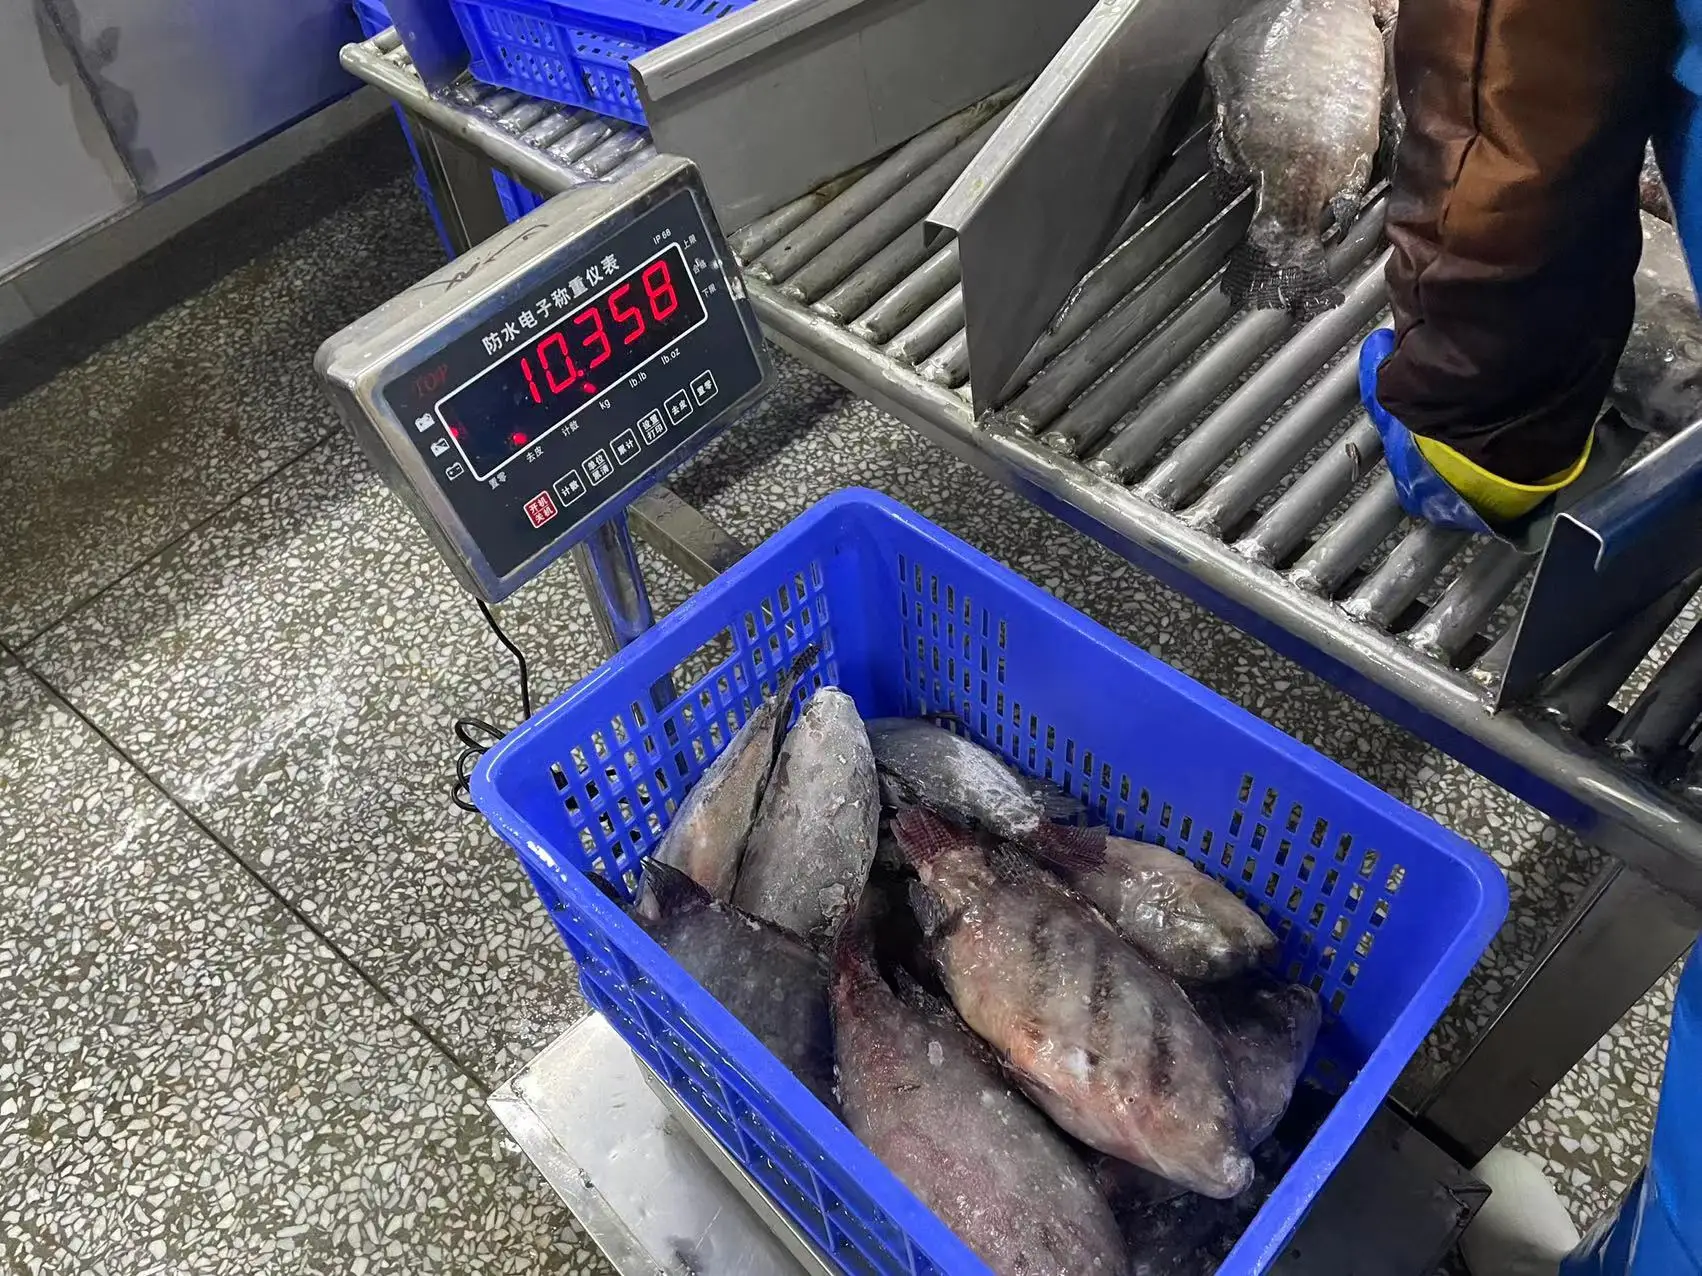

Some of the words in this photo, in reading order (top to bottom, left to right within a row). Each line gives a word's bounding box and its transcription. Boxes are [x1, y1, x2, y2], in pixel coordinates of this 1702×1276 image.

[653, 234, 661, 245] IP
[661, 228, 672, 239] 68
[683, 234, 697, 250] 上限
[701, 283, 717, 298] 下限
[482, 253, 620, 356] 防水电子称重仪表
[520, 260, 678, 404] 10.358
[661, 348, 681, 365] lb.oz
[629, 371, 647, 389] lb.lb
[598, 399, 611, 411] kg
[671, 399, 688, 416] 去皮
[561, 420, 580, 437] 计数
[642, 413, 659, 430] 设置
[647, 424, 664, 440] 打印
[526, 446, 544, 463] 去皮
[617, 439, 634, 456] 累计
[587, 454, 605, 471] 单位
[561, 480, 580, 497] 计数
[529, 496, 548, 514] 开机
[535, 507, 554, 524] 关机
